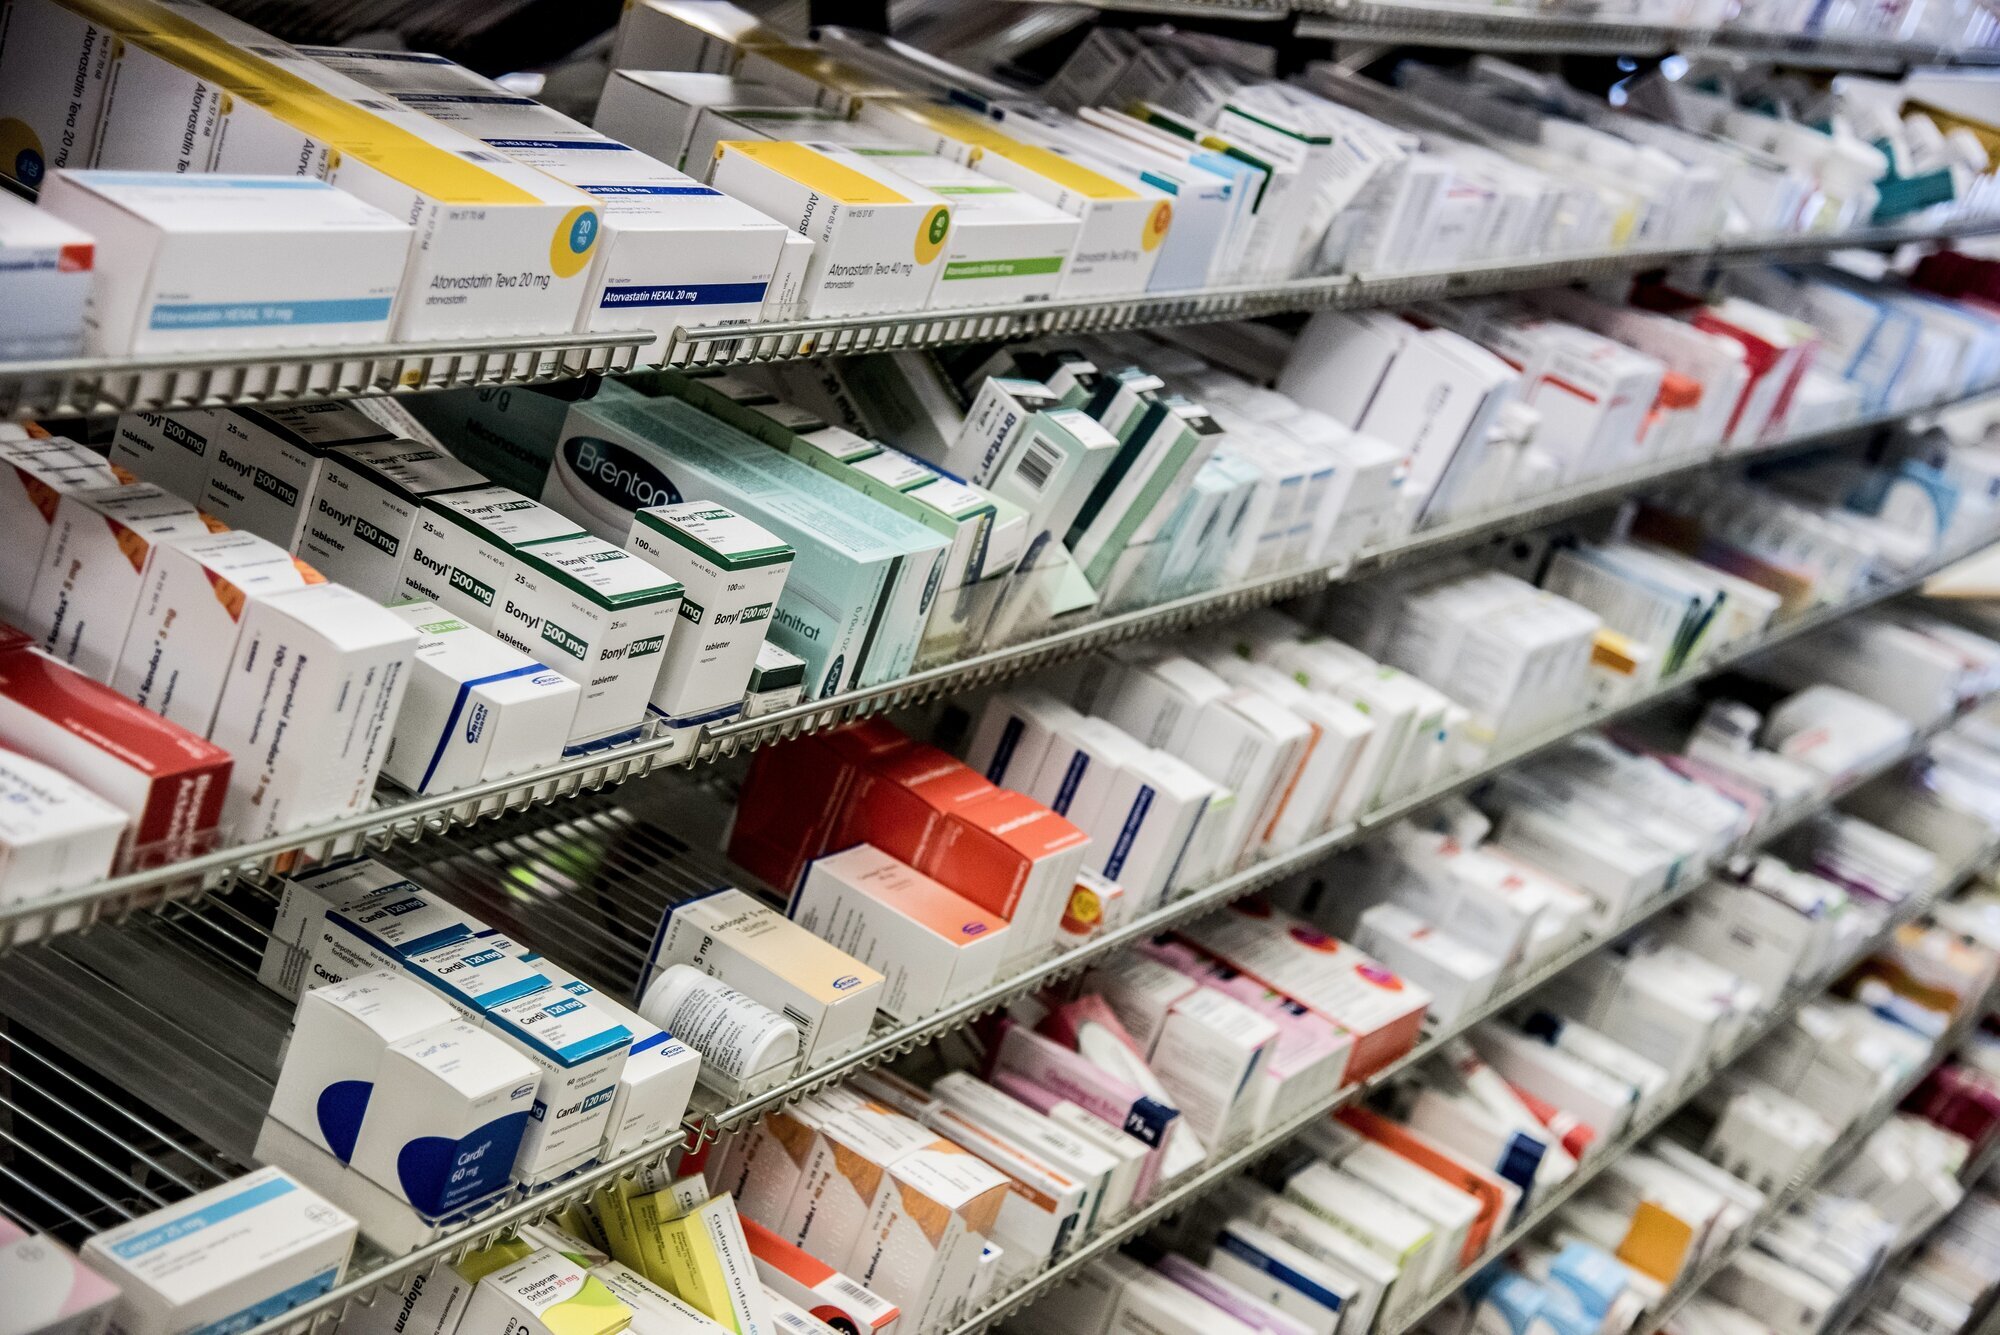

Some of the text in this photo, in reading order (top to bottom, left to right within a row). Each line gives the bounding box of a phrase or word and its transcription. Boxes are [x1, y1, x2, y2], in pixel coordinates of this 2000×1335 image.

[54, 25, 97, 169] Atorvastatin Teva 20 mg
[181, 82, 207, 156] Atorvastatin
[579, 220, 592, 234] 20
[430, 272, 551, 290] Atorvastatin Teva 20 mg
[828, 262, 913, 277] Atorvastatin Teva 40 mg
[425, 295, 467, 306] atorvastatin
[604, 290, 697, 302] Atorvastatin HEXAL 20 mg
[122, 429, 155, 452] tabletter
[166, 423, 204, 452] 500 mg
[227, 424, 238, 434] 25
[982, 411, 1016, 477] Brentan
[328, 473, 349, 491] 25 tabl.
[576, 442, 669, 506] Brentan
[212, 478, 245, 502] tabletter
[256, 472, 277, 490] 500
[278, 486, 296, 503] mg
[312, 528, 345, 552] tabletter
[356, 523, 378, 540] 500
[378, 536, 397, 554] mg
[423, 522, 445, 539] 25 tabl.
[308, 543, 330, 558] naproxen
[635, 537, 660, 557] 100 tabl.
[691, 560, 699, 568] Vnr
[405, 577, 440, 601] tabletter
[452, 571, 473, 590] 500
[474, 585, 493, 604] mg
[515, 573, 537, 592] 25 tabl.
[727, 583, 737, 592] 100
[48, 599, 68, 644] Sandoz
[682, 602, 702, 622] mg
[742, 607, 757, 619] 500
[757, 606, 772, 618] mg
[426, 621, 467, 633] 250 mg
[610, 621, 619, 630] 25
[496, 630, 532, 654] tabletter
[543, 623, 566, 643] 500
[566, 638, 586, 658] mg
[630, 641, 647, 654] 500
[647, 639, 662, 652] mg
[705, 641, 730, 651] tabletter
[141, 649, 162, 693] Sandoz
[591, 675, 619, 686] tabletter
[282, 654, 308, 720] Bisoprolol
[467, 702, 485, 744] ORION
[266, 720, 287, 765] Sandoz
[359, 900, 424, 923] Cardil 120 mg
[324, 934, 333, 943] 60
[693, 936, 713, 965] 5 mg
[438, 951, 503, 974] Cardil 120 mg
[568, 983, 589, 995] mg
[833, 975, 859, 989] ORION
[520, 1000, 584, 1025] Cardil 120 mg
[661, 1045, 683, 1056] ORION
[567, 1078, 575, 1086] 60
[556, 1090, 613, 1119] Cardil 120 mg
[451, 1166, 479, 1183] 60 mg
[798, 1206, 817, 1240] Sandoz
[713, 1213, 737, 1278] Citalopram
[734, 1277, 752, 1321] Orifarm
[865, 1247, 883, 1280] Sandoz
[518, 1273, 558, 1296] Citalopram
[526, 1274, 580, 1302] Orifarm 30 mg
[621, 1272, 704, 1324] Citalopram Sandoz
